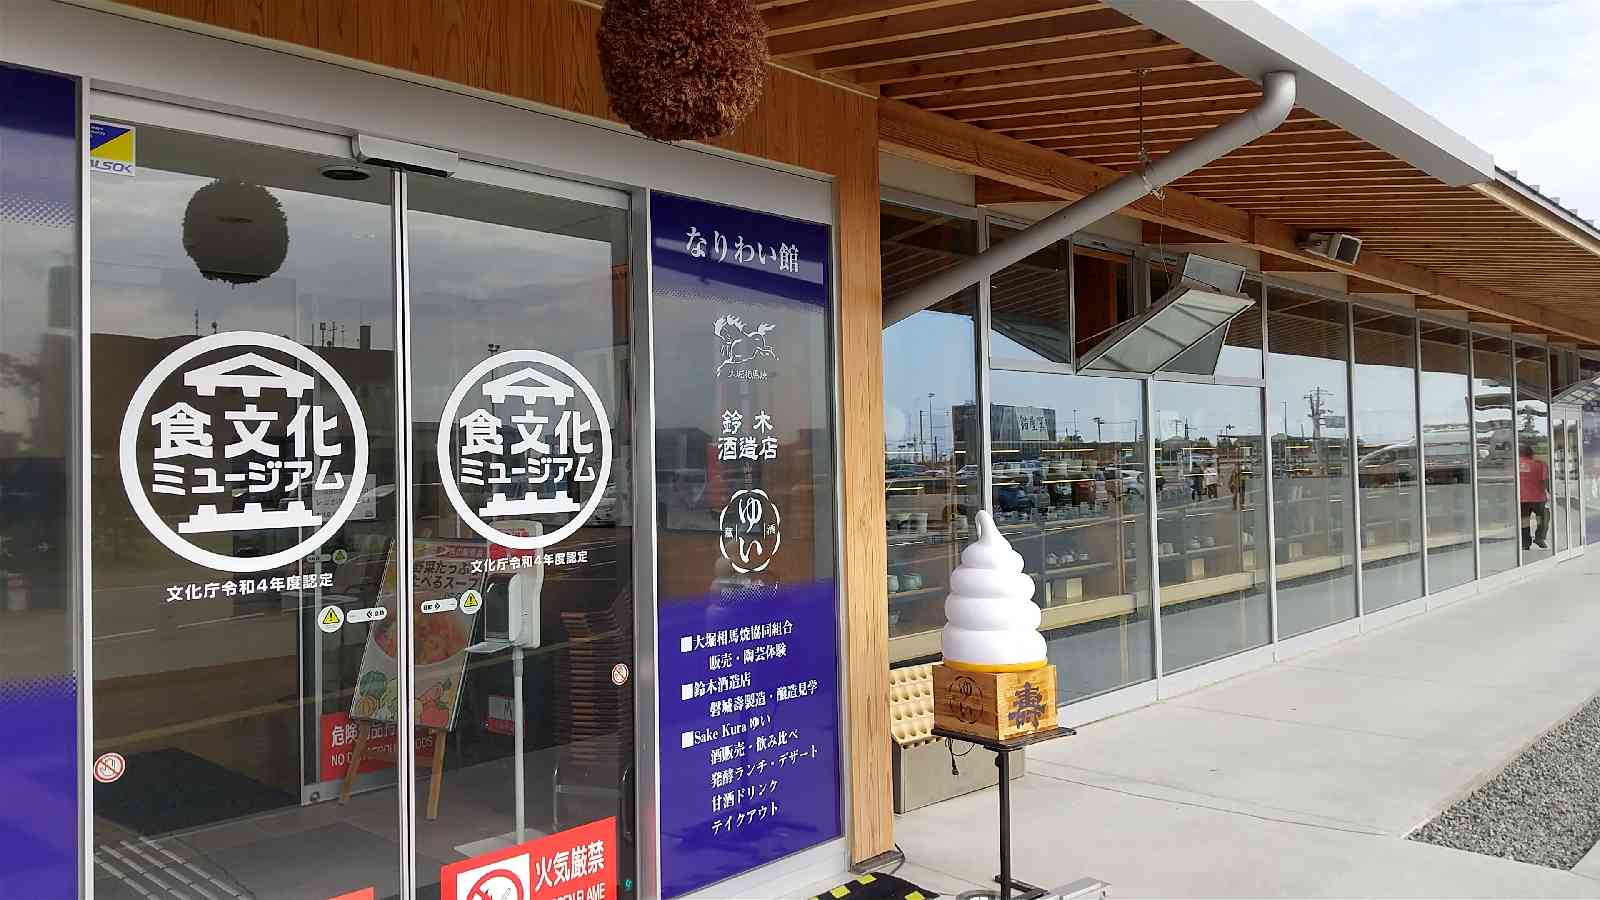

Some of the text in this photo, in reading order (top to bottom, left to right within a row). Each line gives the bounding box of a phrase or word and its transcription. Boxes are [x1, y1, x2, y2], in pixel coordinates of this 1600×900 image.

[685, 226, 799, 273] なりわい館
[151, 401, 342, 459] 食文化
[459, 408, 594, 456] 食文化
[721, 409, 774, 434] 鈴木
[717, 436, 778, 461] 酒造店
[151, 460, 345, 496] ミュージアム
[460, 456, 596, 486] ミュージアム
[738, 497, 763, 564] ゆい
[471, 551, 588, 573] 文化庁令和4年度認定
[166, 573, 333, 602] 文化庁令和4年度認定
[693, 619, 794, 650] 大堀相馬焼協同組合
[709, 642, 788, 671] 販売・陶芸体験
[693, 671, 751, 698] 鈴木酒造店
[694, 715, 771, 745] Sake Kura ゆい
[331, 752, 346, 767] NO
[710, 729, 800, 765] 酒販売・飲み比べ
[711, 744, 818, 789] 発酵ランチ・デザート
[711, 779, 779, 813] 甘酒ドリンク
[711, 801, 779, 837] テイクアウト
[535, 839, 605, 892] 火気厳禁
